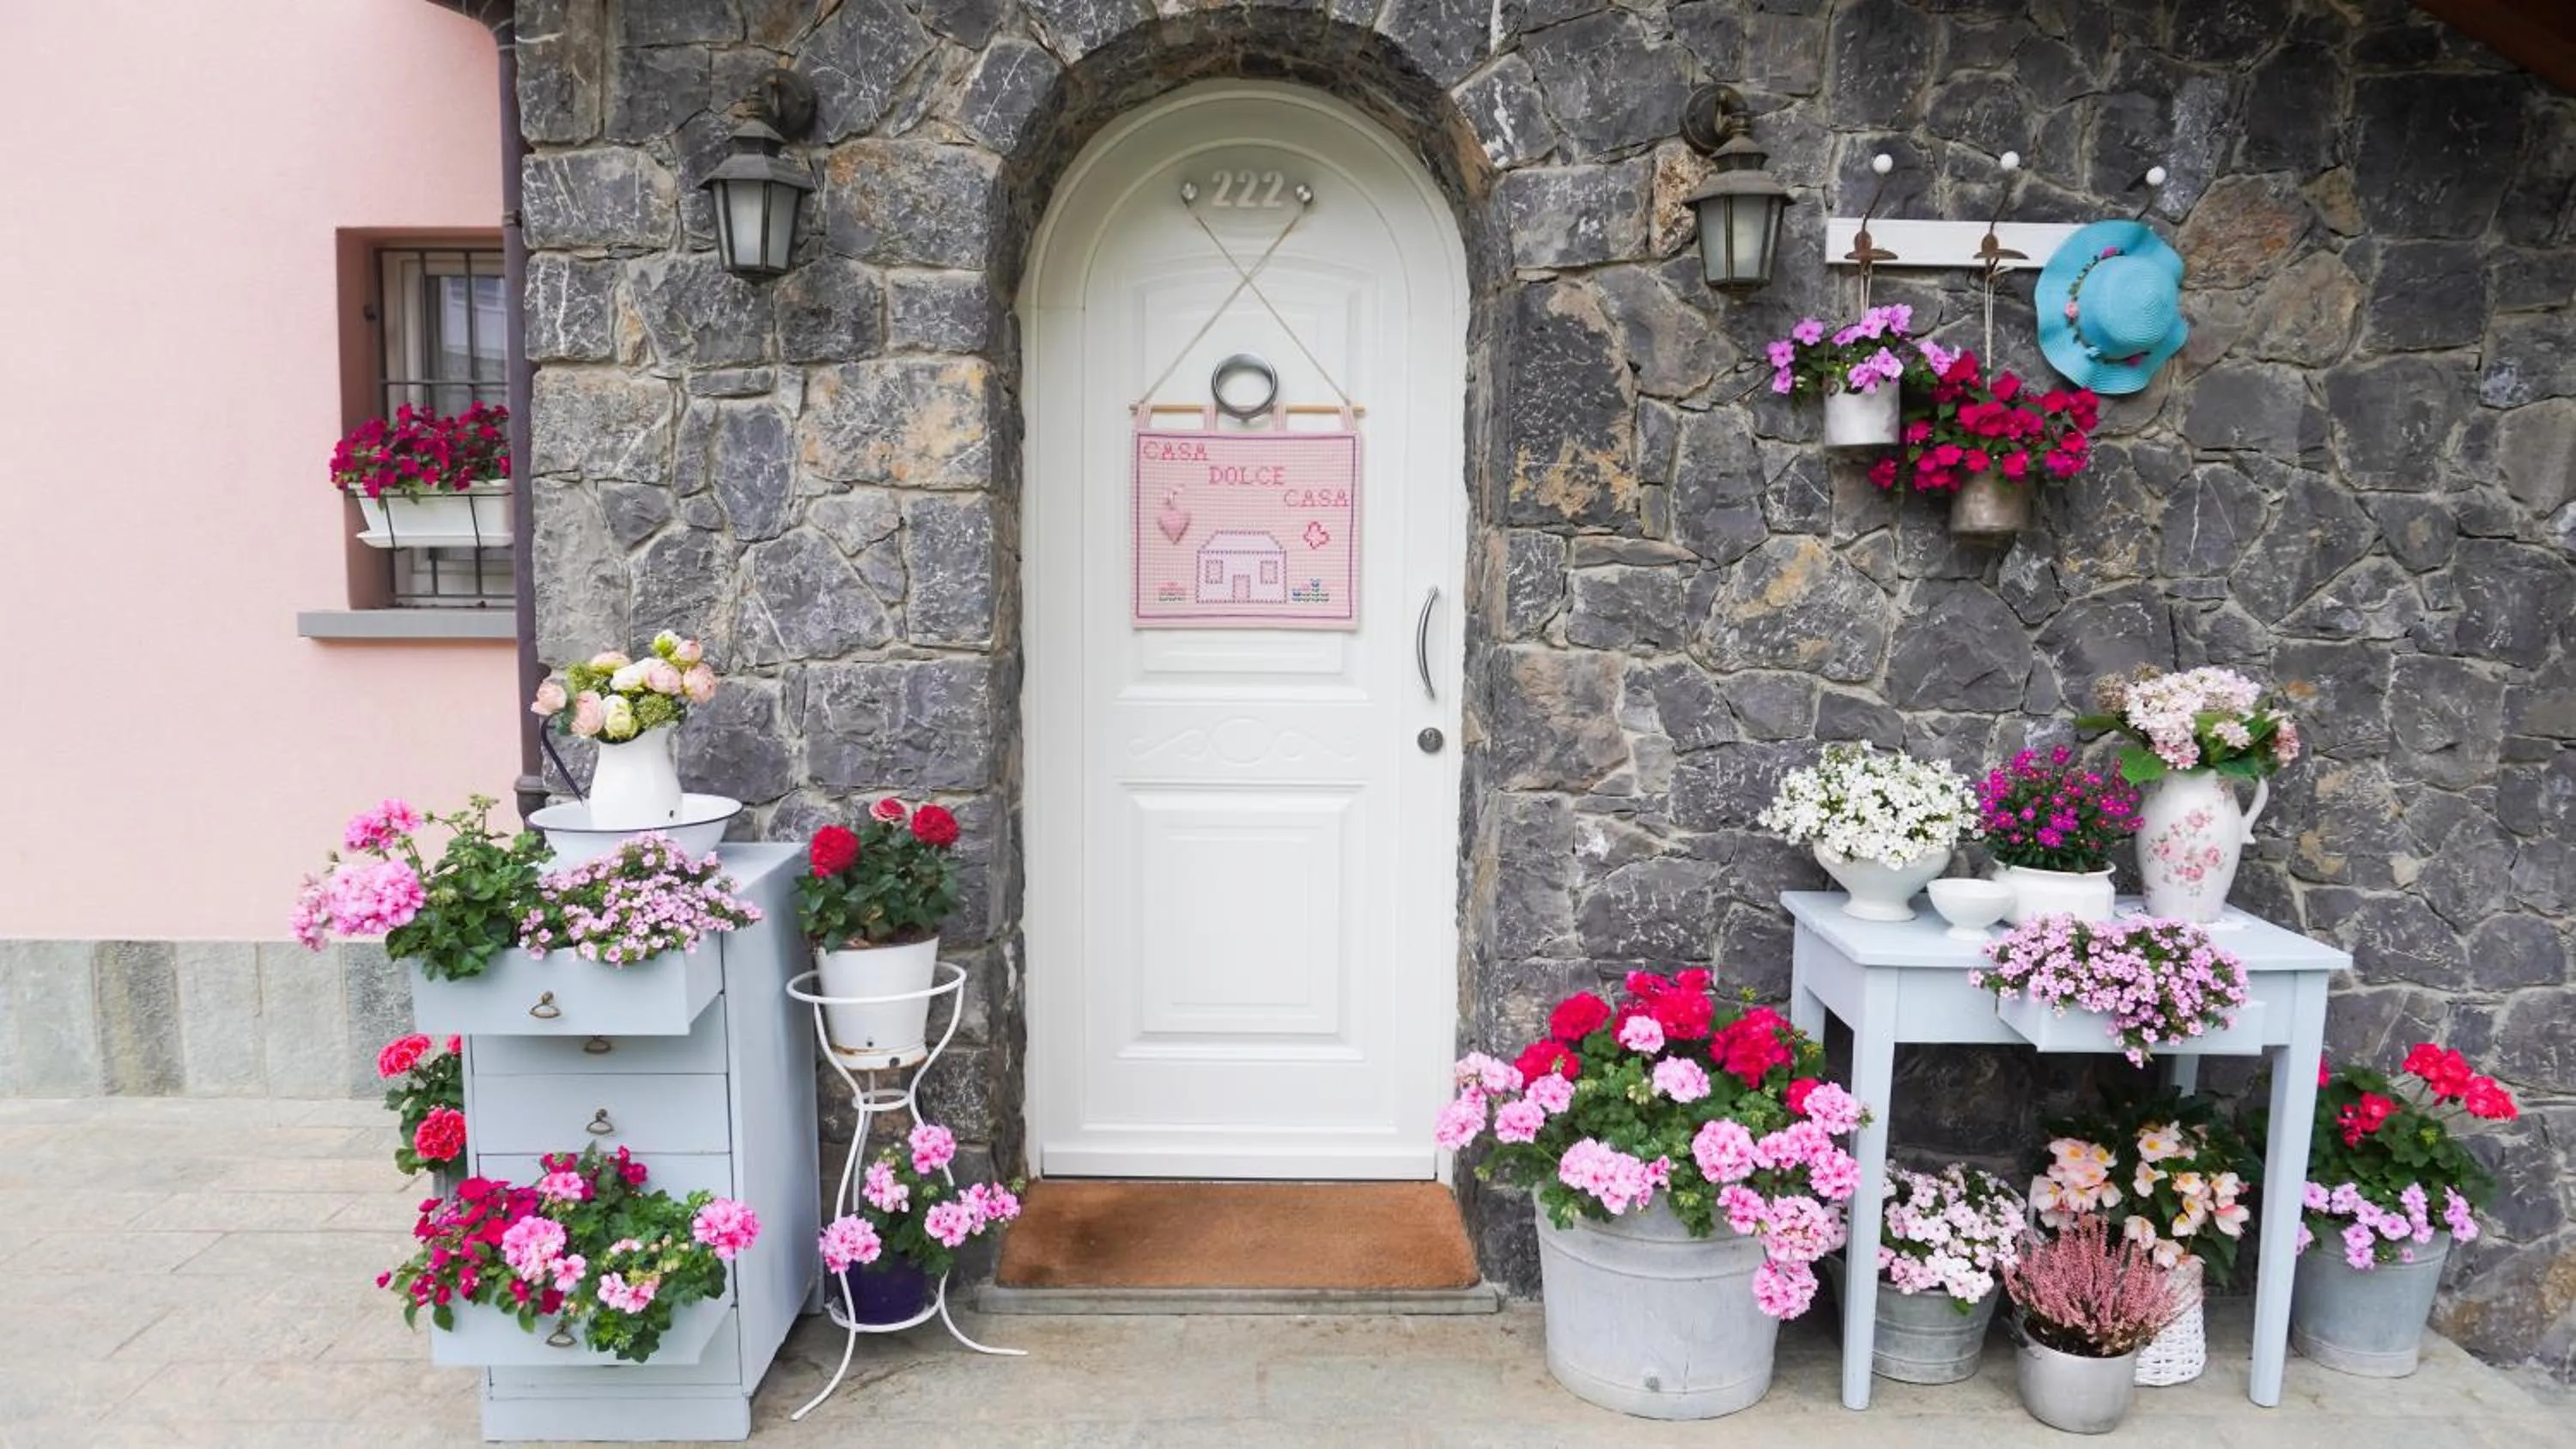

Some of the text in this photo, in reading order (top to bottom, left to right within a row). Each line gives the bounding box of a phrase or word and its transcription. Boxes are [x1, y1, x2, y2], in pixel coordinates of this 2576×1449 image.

[1211, 171, 1284, 207] 222
[1143, 441, 1209, 460] CASA
[1209, 466, 1285, 485] DOLCE
[1284, 488, 1349, 507] CASA
